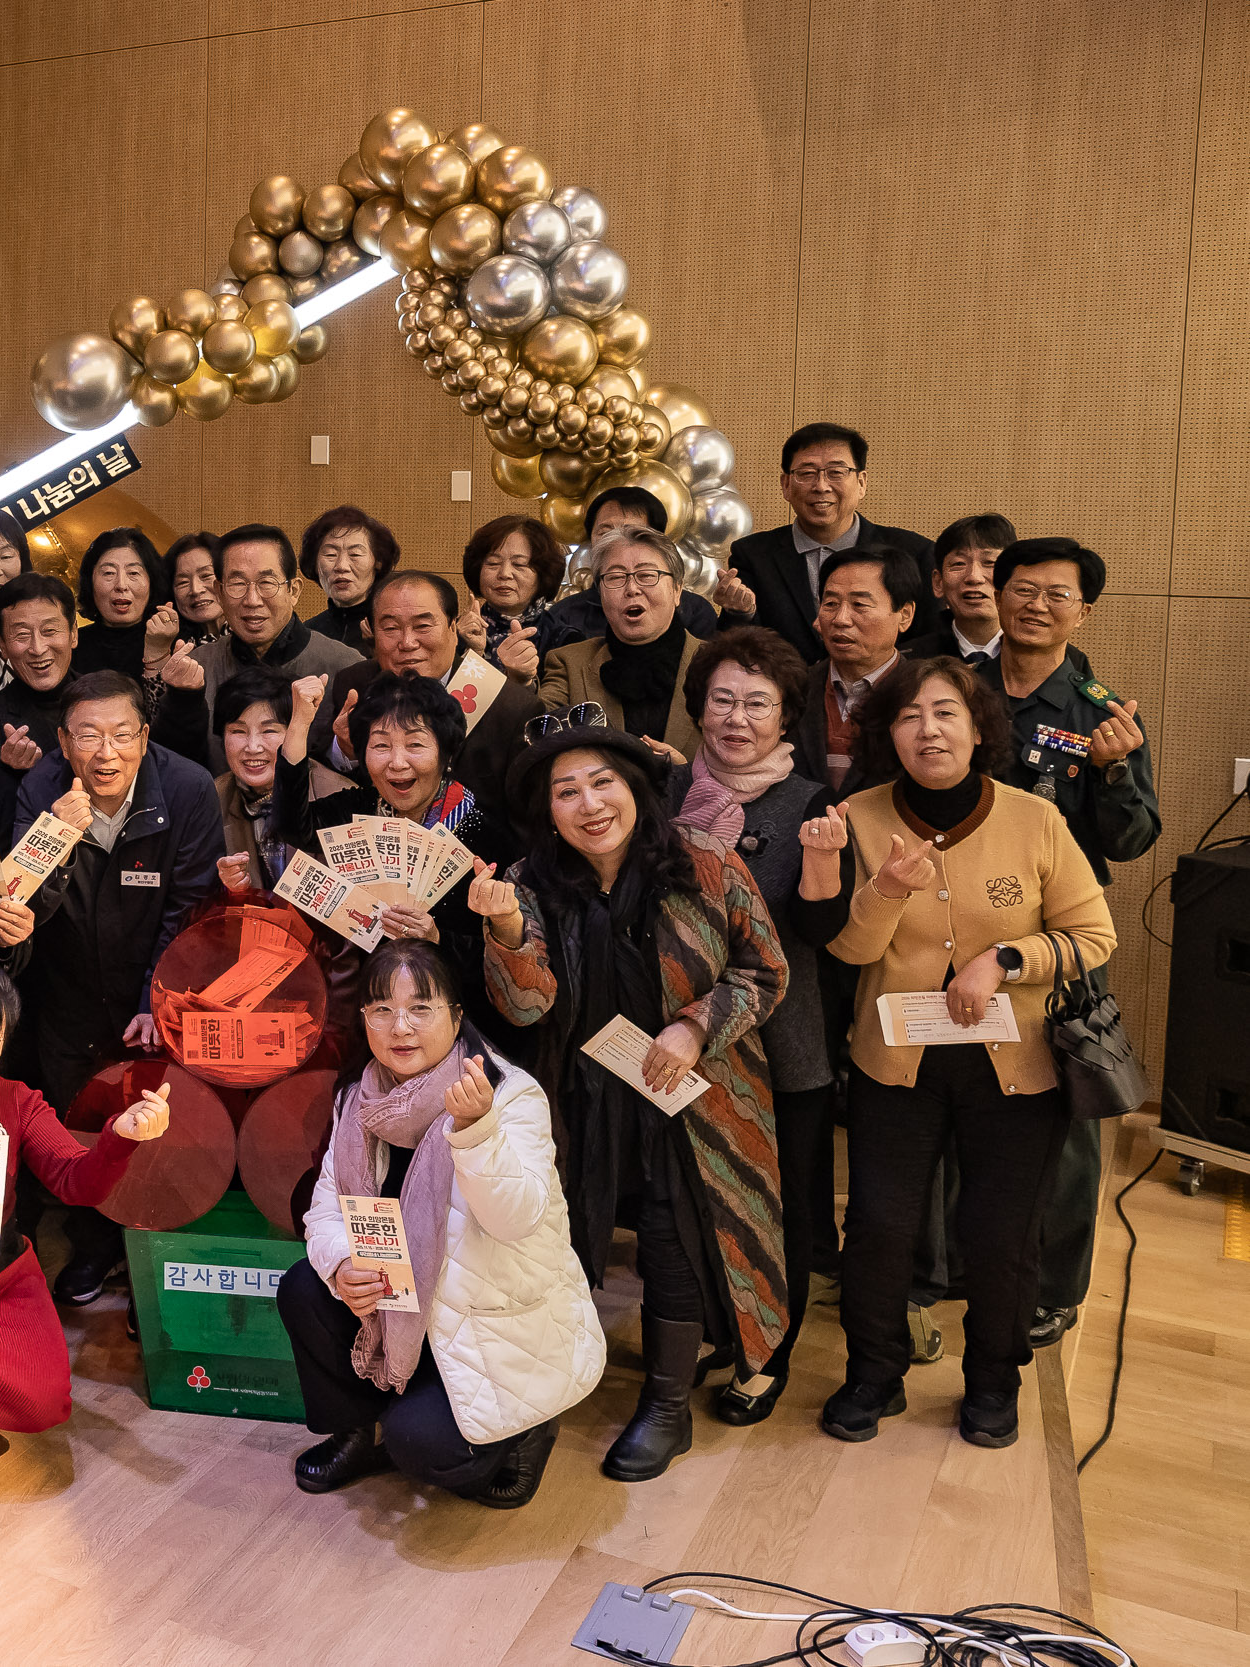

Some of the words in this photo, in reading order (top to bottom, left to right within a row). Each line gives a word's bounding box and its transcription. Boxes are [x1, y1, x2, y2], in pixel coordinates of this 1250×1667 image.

[17, 460, 101, 520] 나눔의
[96, 442, 132, 477] 날
[35, 829, 48, 838] 2026
[27, 834, 62, 857] 따뜻한
[375, 842, 401, 855] 뜻한
[21, 844, 54, 864] 겨울나기
[331, 846, 372, 864] 따뜻한
[380, 855, 400, 865] 나기
[335, 859, 375, 873] 겨울나기
[292, 886, 303, 899] 2026
[298, 870, 327, 906] 따뜻한
[310, 876, 336, 912] 겨울나기
[208, 1018, 220, 1059] 따뜻한
[350, 1222, 397, 1236] 따뜻한
[354, 1235, 399, 1246] 겨울나기
